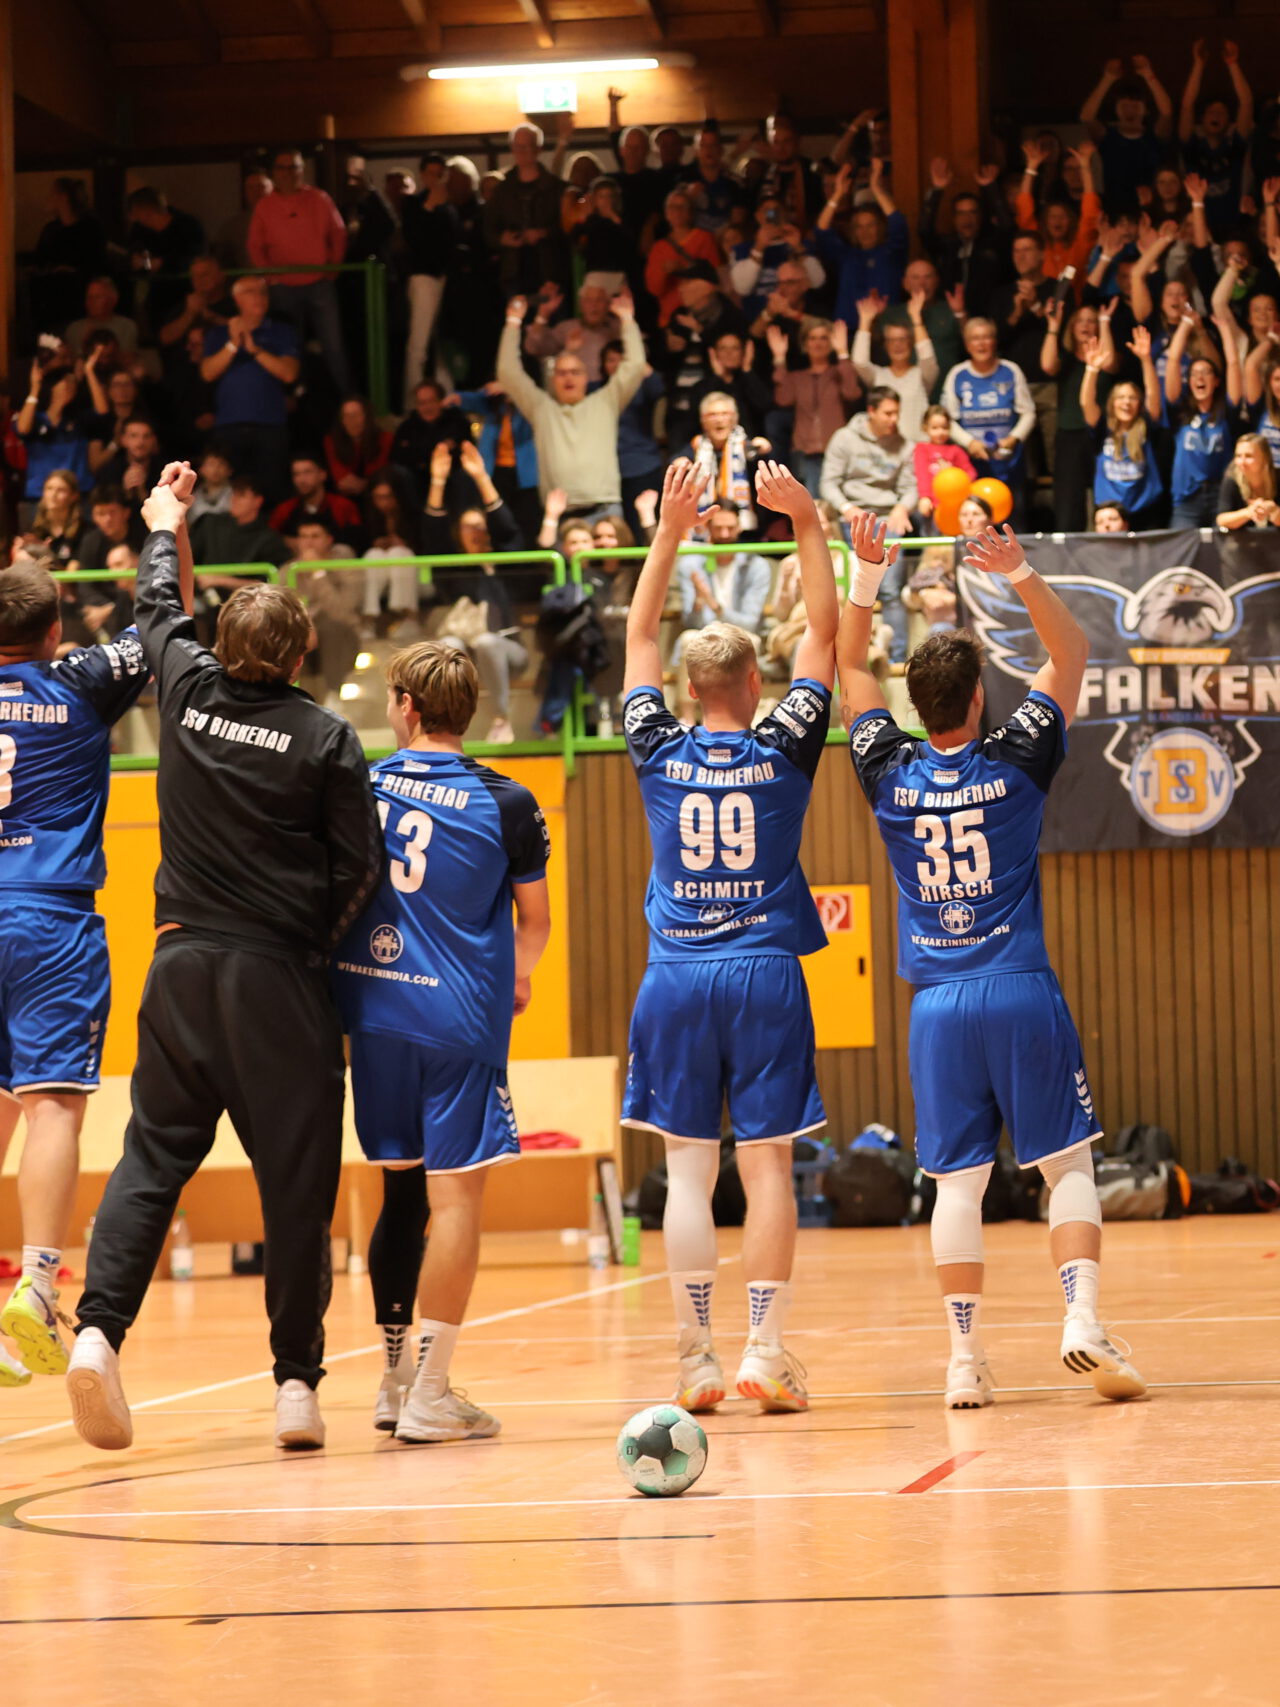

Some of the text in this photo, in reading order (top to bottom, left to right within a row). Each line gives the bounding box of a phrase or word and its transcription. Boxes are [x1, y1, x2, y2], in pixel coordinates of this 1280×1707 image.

[208, 716, 293, 753] BIRKENAU
[665, 760, 775, 786] TSV BIRKENAU
[381, 773, 471, 810] BIRKENAU
[894, 778, 1007, 808] TSV BIRKENAU
[679, 792, 756, 872] 99
[914, 808, 991, 886] 35
[674, 880, 765, 899] SCHMITT
[919, 880, 993, 903] HIRSCH
